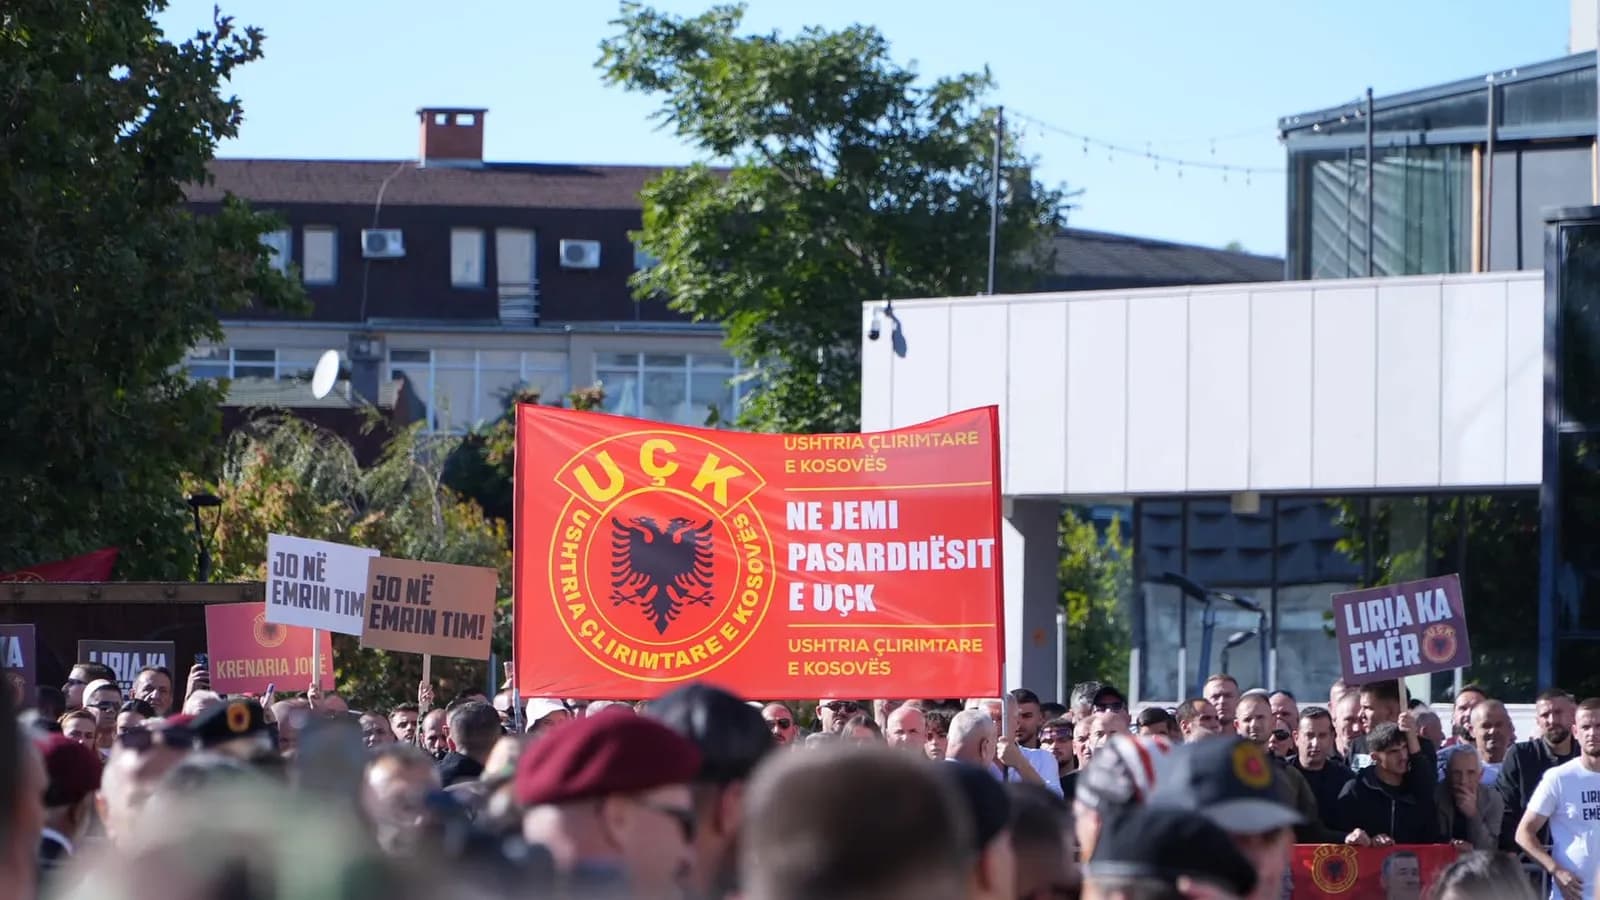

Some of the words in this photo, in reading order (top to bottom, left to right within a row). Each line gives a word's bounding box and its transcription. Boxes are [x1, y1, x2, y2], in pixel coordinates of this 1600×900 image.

[784, 435, 865, 451] USHTRIA
[868, 431, 979, 453] ÇLIRIMTARE
[572, 438, 745, 508] UÇK
[785, 459, 796, 473] E
[800, 454, 888, 473] KOSOVËS
[786, 501, 824, 531] NE
[830, 500, 899, 531] JEMI
[273, 552, 299, 579] JO
[302, 552, 327, 582] NË
[788, 535, 995, 572] PASARDHËSIT
[271, 579, 330, 612] EMRIN
[372, 575, 401, 602] JO
[406, 574, 435, 606] NË
[560, 508, 592, 621] USHTRIA
[578, 618, 724, 670] ÇLIRIMTARE
[719, 622, 740, 642] E
[733, 513, 764, 626] KOSOVËS
[788, 582, 804, 611] E
[813, 583, 877, 617] UÇK
[368, 604, 437, 635] EMRIN
[441, 611, 486, 641] TIM!
[1344, 595, 1414, 636] LIRIA
[1415, 588, 1453, 624] KA
[788, 638, 870, 653] USHTRIA
[873, 638, 983, 657] ÇLIRIMTARE
[1349, 628, 1422, 675] EMËR
[217, 658, 290, 679] KRENARIA
[293, 653, 327, 676] JOË
[788, 661, 799, 675] E
[804, 658, 891, 675] KOSOVËS
